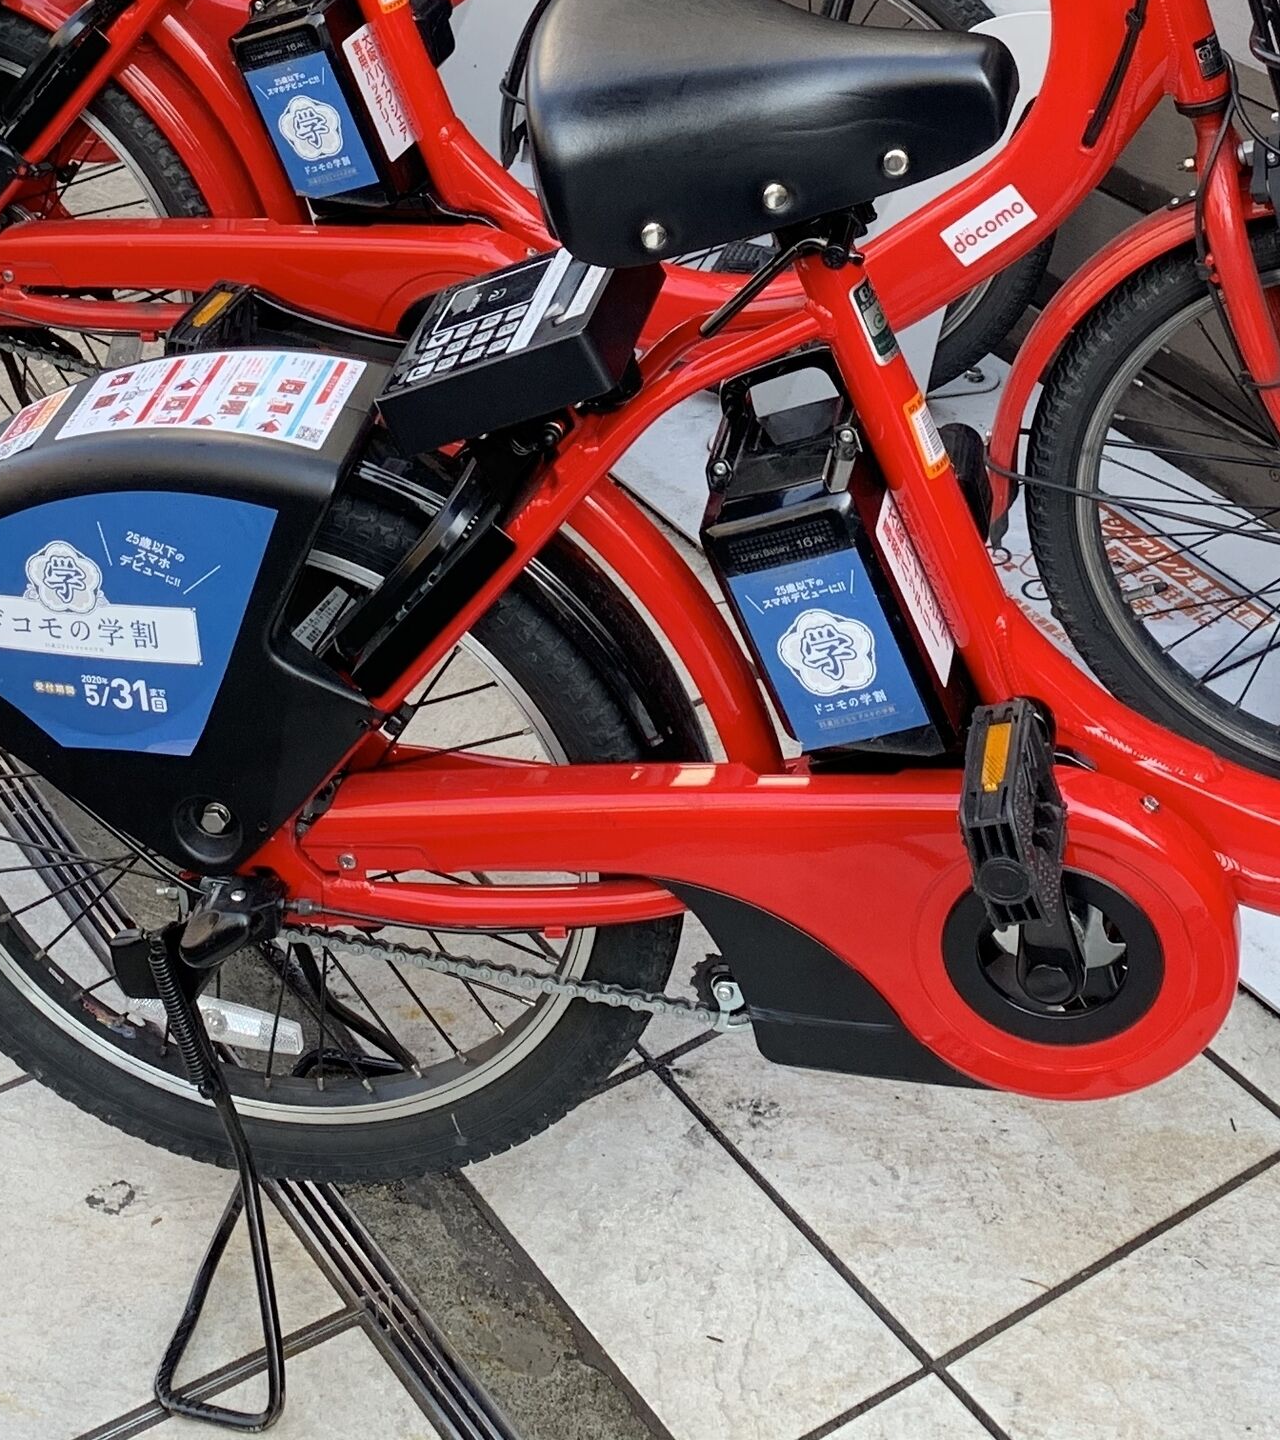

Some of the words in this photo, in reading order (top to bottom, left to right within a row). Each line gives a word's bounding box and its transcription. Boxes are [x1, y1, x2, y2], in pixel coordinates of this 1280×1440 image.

[351, 41, 395, 136] 専用バッテリー
[362, 33, 407, 142] 大阪バイクシェア
[294, 108, 330, 148] 学
[954, 201, 1024, 254] docomo
[125, 531, 185, 562] 25歳以下の
[135, 548, 170, 569] スマホ
[796, 536, 812, 550] 16
[43, 555, 87, 603] 学
[120, 554, 181, 587] デビューに!!
[774, 577, 824, 596] 25歳以下の
[801, 624, 857, 681] 学
[84, 677, 150, 711] 5/31
[813, 689, 888, 715] ドコモの学割
